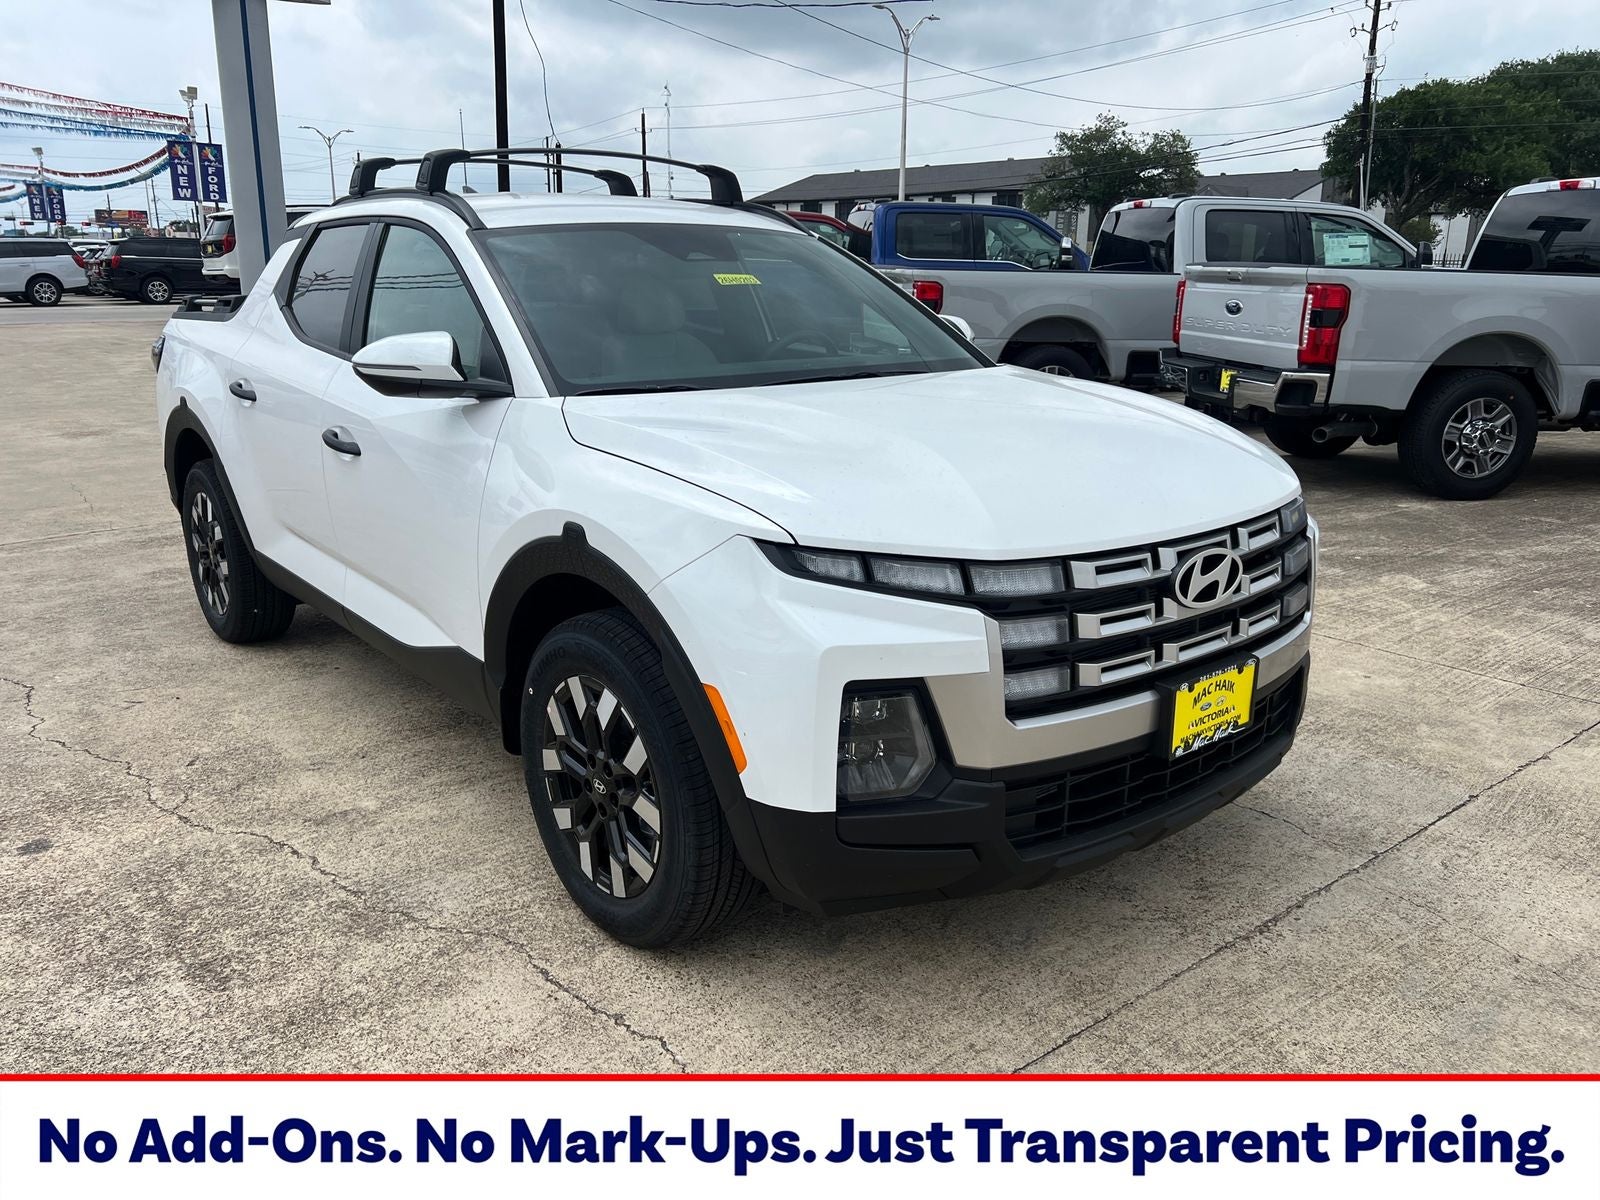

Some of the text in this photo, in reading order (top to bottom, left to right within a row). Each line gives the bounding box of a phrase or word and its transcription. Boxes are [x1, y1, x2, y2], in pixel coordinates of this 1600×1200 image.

[177, 165, 192, 198] NEW
[207, 167, 220, 200] FORD
[33, 198, 43, 219] NEW
[52, 198, 62, 220] FORD
[1185, 316, 1293, 337] SUPER DUTY
[1192, 682, 1213, 709] MAC
[1214, 679, 1235, 694] HAIK
[1195, 707, 1231, 728] VICTORIA
[1191, 735, 1213, 751] Mac
